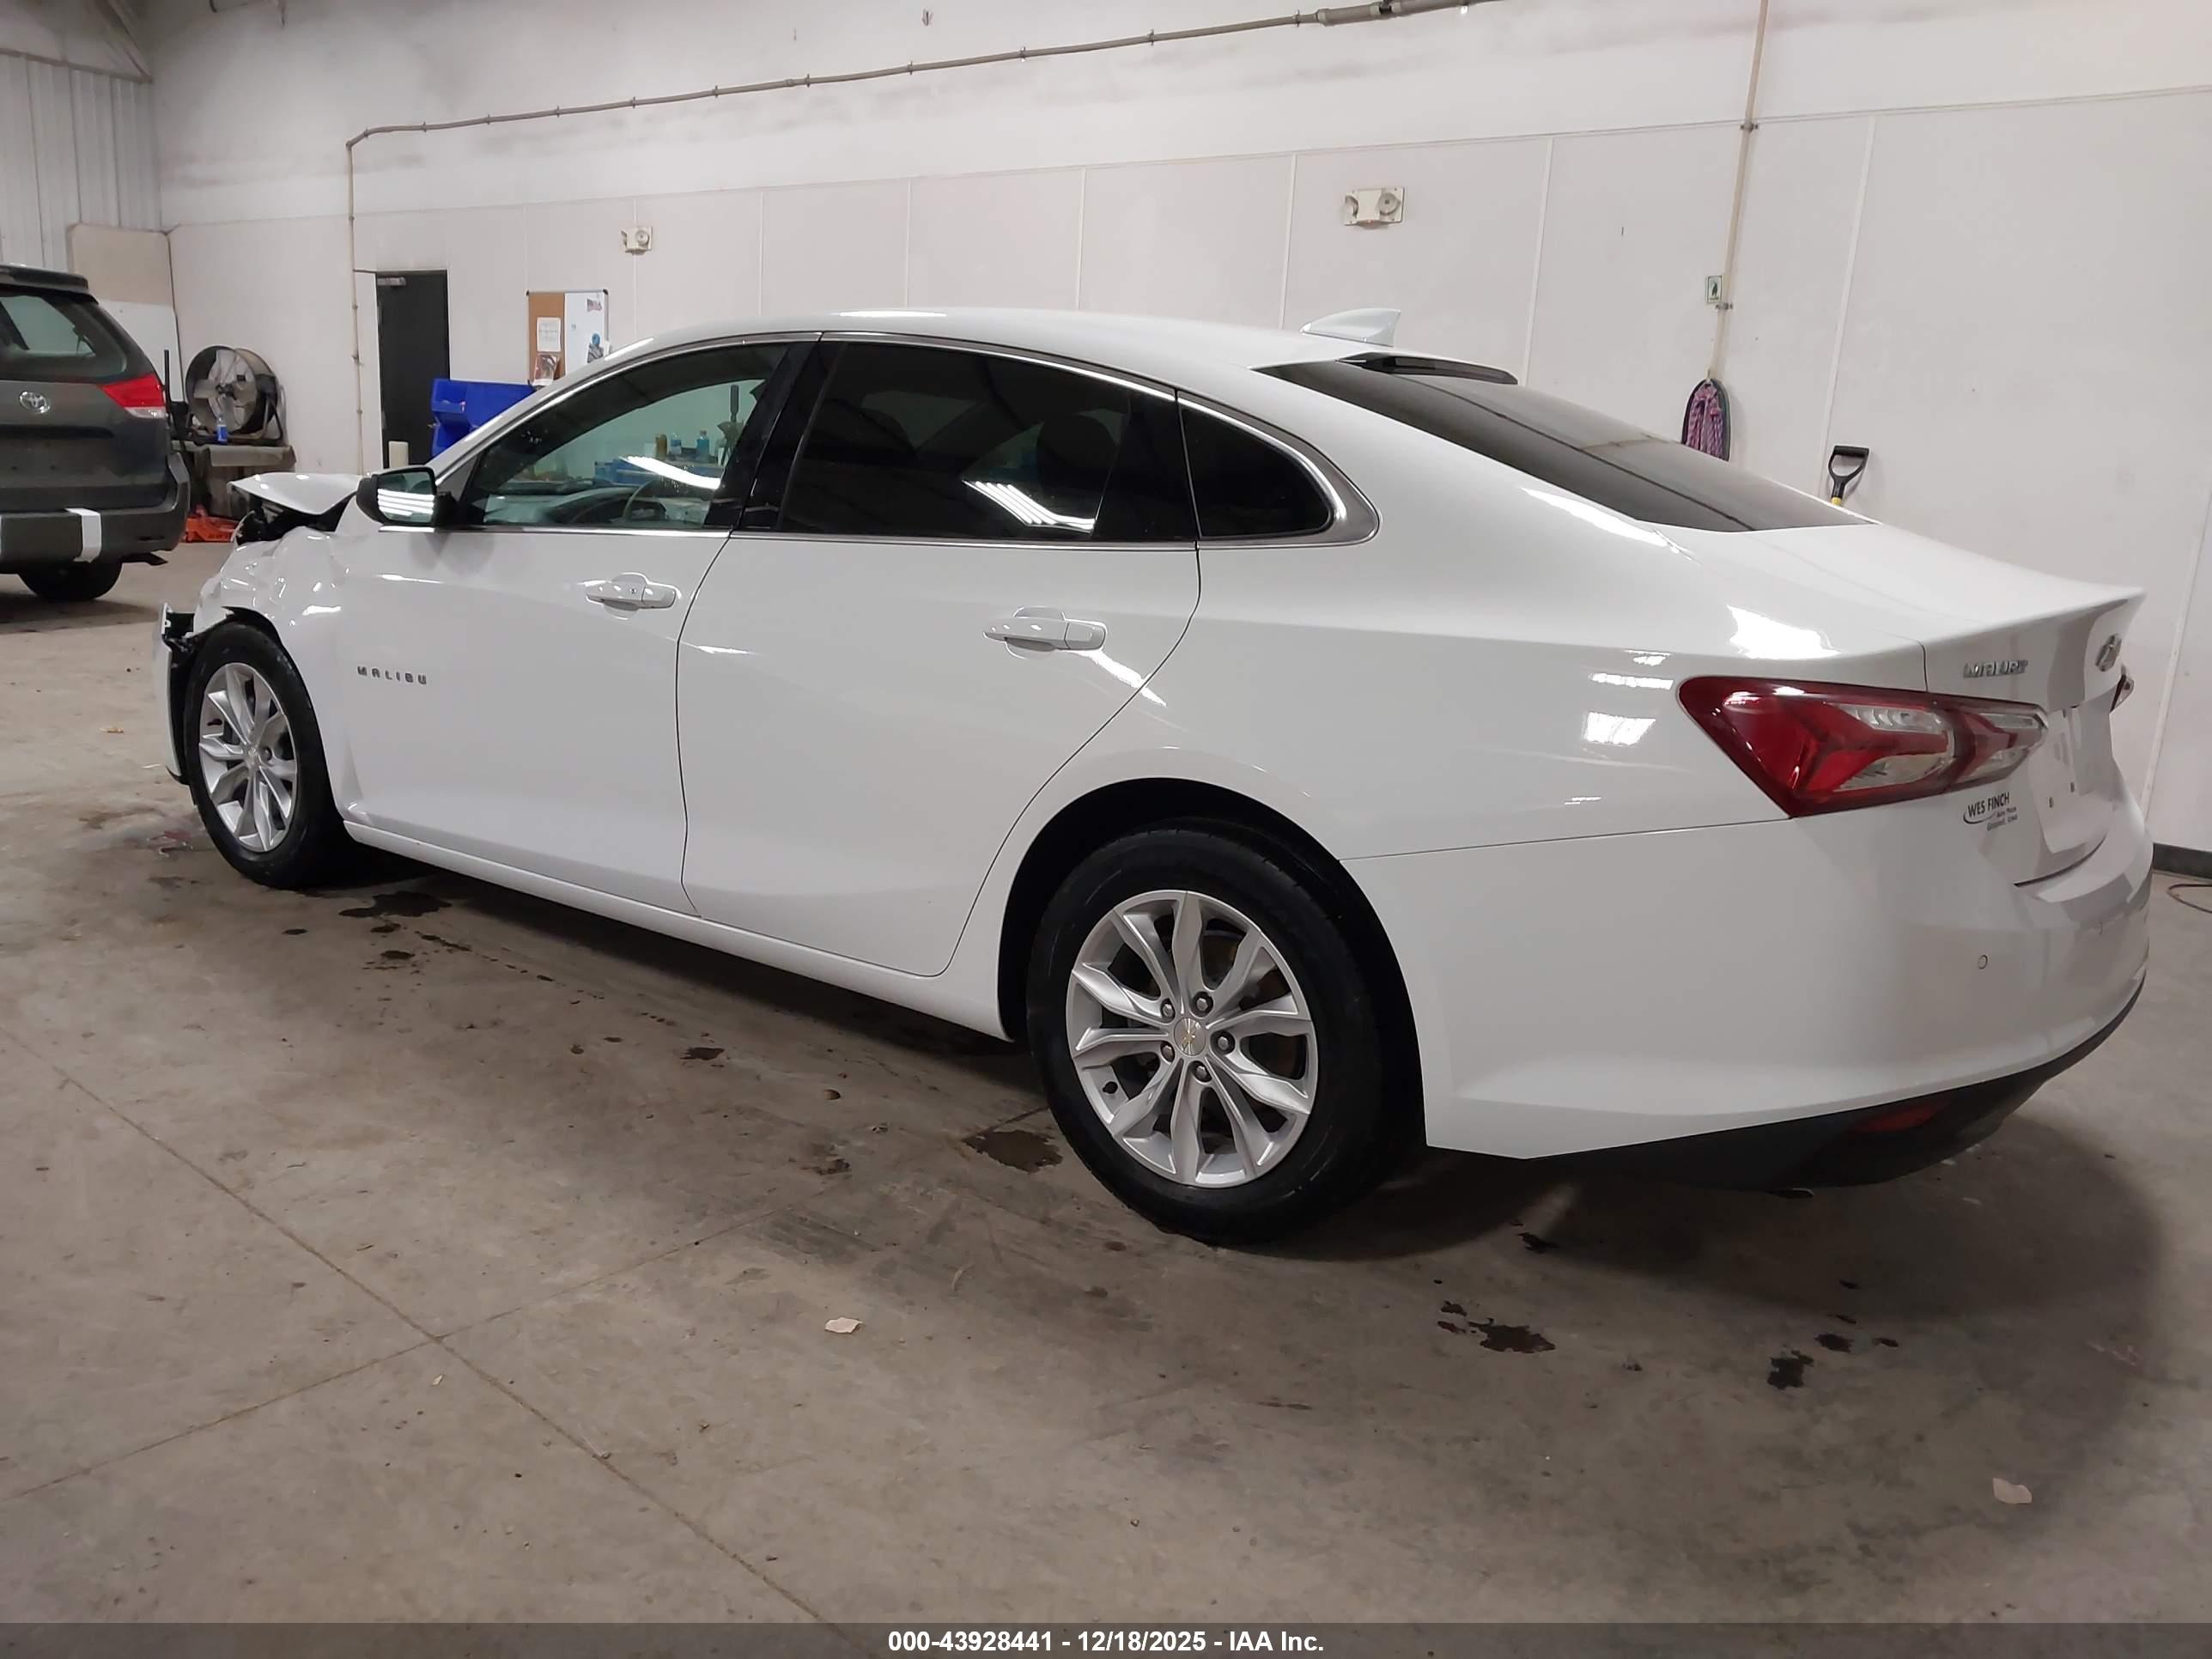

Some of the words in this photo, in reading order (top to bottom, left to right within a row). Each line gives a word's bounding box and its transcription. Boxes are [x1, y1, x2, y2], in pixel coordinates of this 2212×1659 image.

[357, 665, 427, 685] MALIBU
[1967, 799, 1985, 817] WES
[1987, 792, 2010, 811] FINCH
